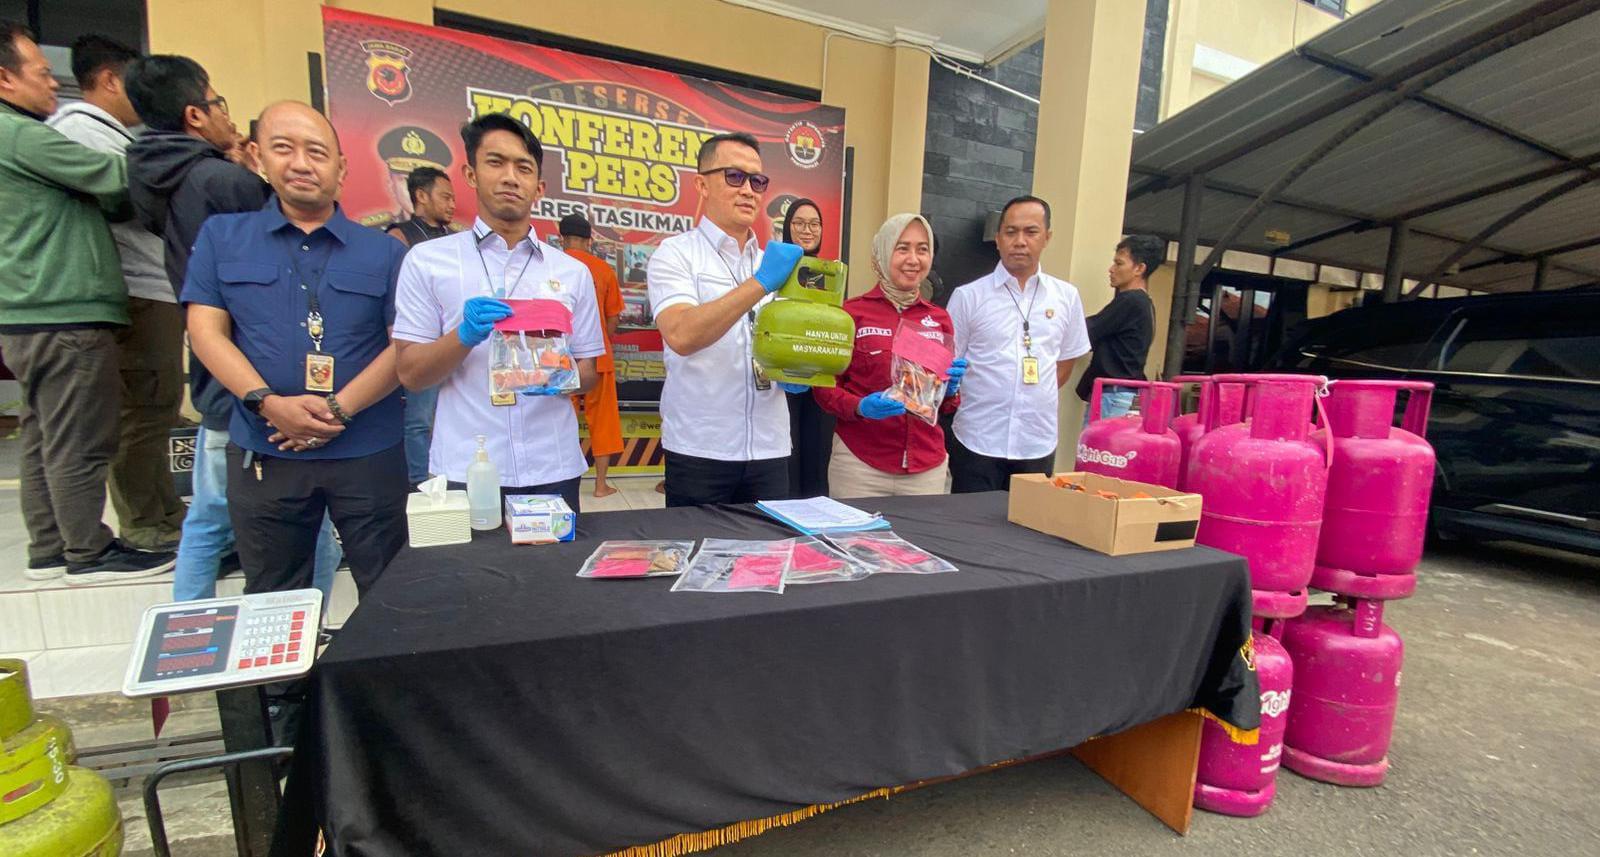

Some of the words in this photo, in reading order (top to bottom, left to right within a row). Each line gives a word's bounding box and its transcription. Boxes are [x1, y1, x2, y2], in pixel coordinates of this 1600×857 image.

[549, 84, 689, 125] RESERSE
[567, 151, 676, 201] PERS
[805, 330, 829, 340] HANYA
[830, 332, 848, 341] UNTUK
[792, 344, 838, 355] MASYARAKAT
[1100, 450, 1127, 468] Gas
